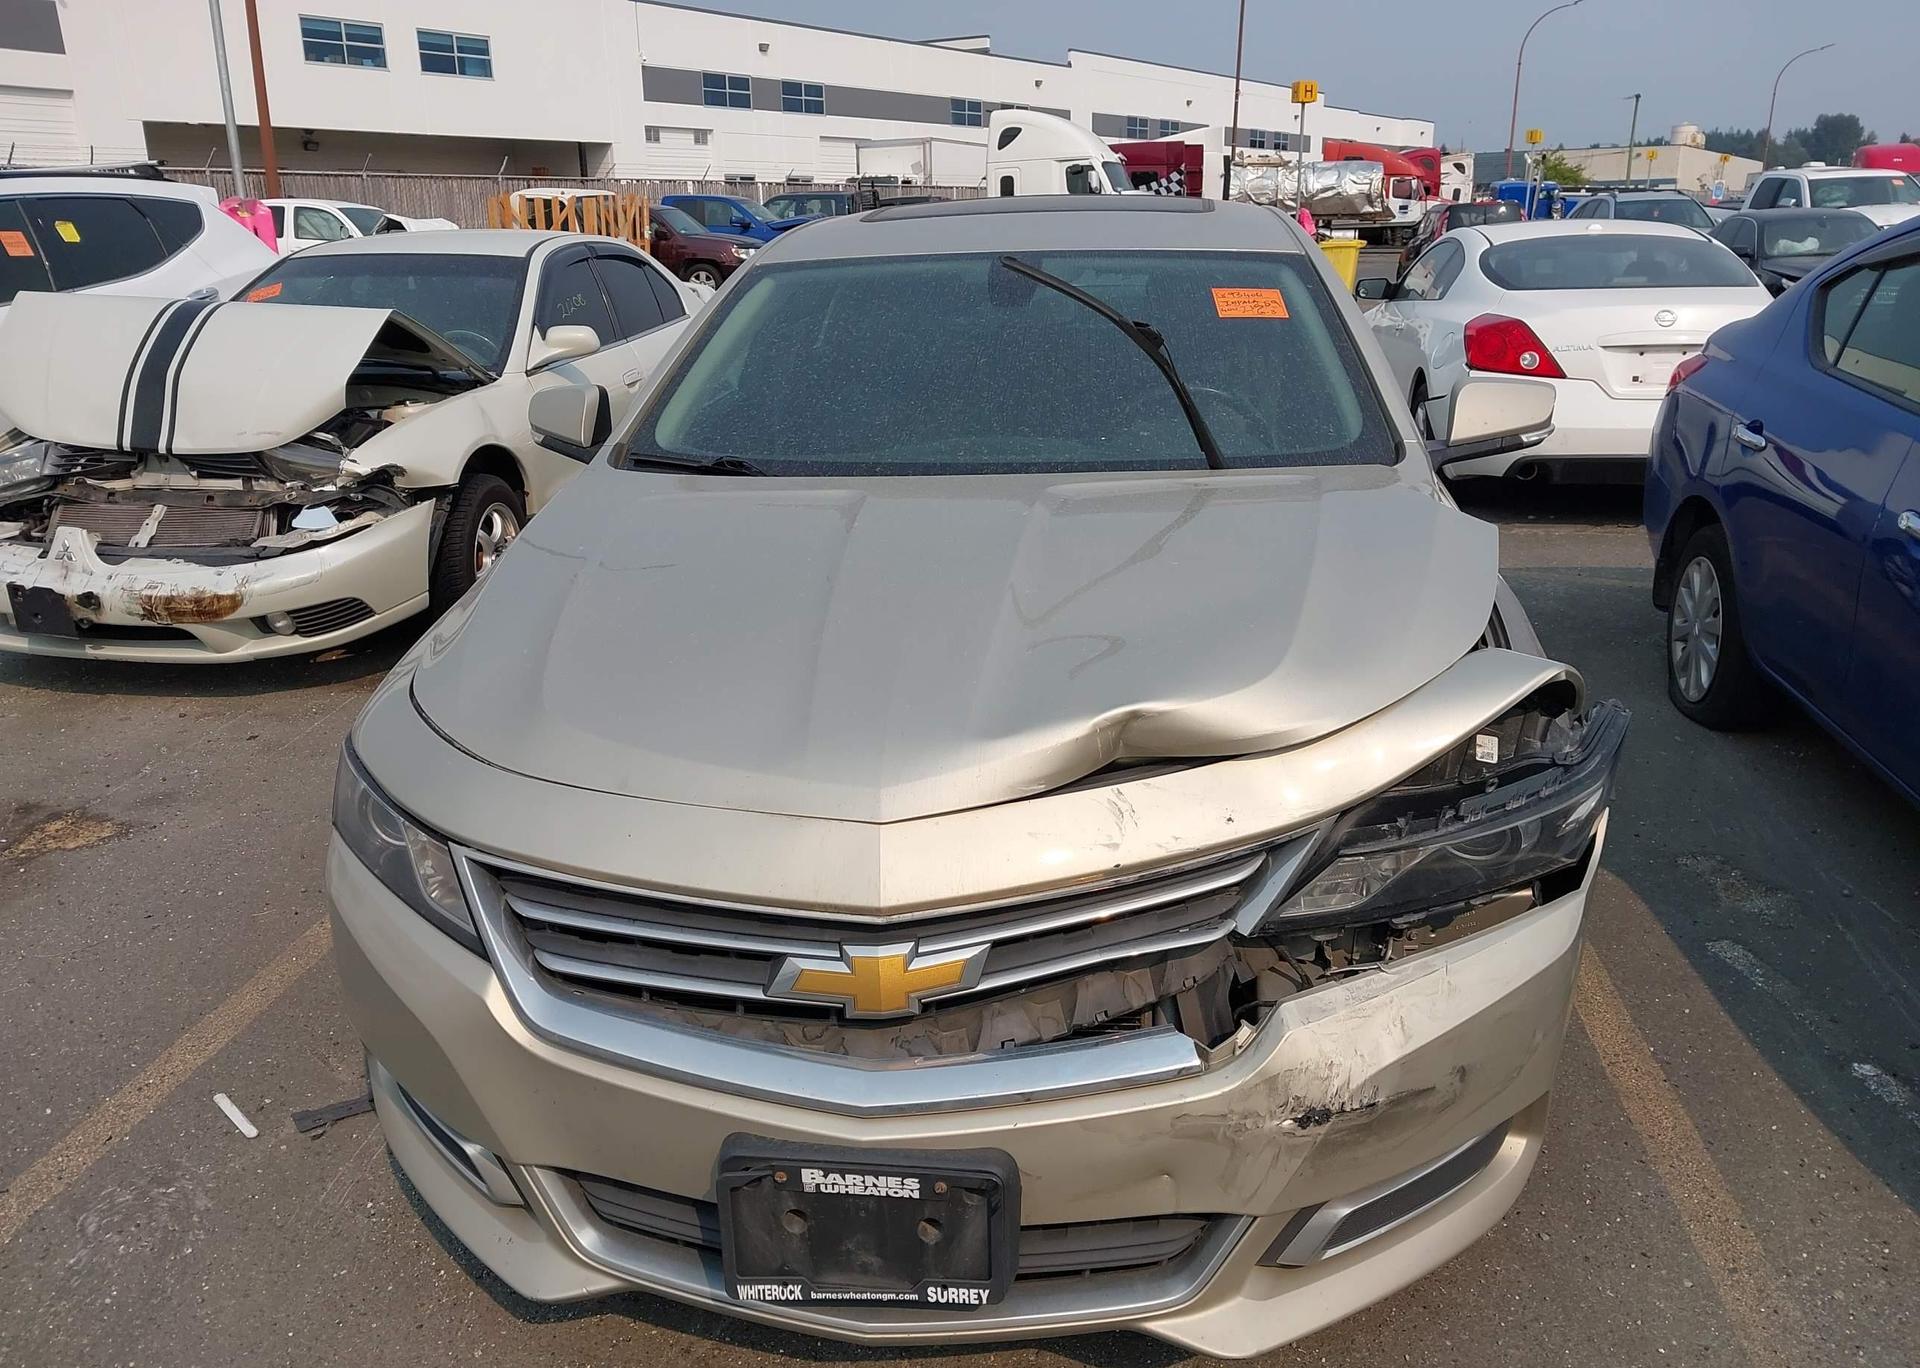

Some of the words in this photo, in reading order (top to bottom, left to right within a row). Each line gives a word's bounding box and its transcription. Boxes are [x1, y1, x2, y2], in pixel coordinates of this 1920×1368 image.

[1304, 84, 1313, 98] H
[801, 1168, 920, 1190] BARNES
[820, 1184, 920, 1199] WHEATON
[736, 1284, 803, 1301] WHITEROCK
[810, 1291, 919, 1302] barneswheatongm.com
[926, 1286, 990, 1305] SURREY
